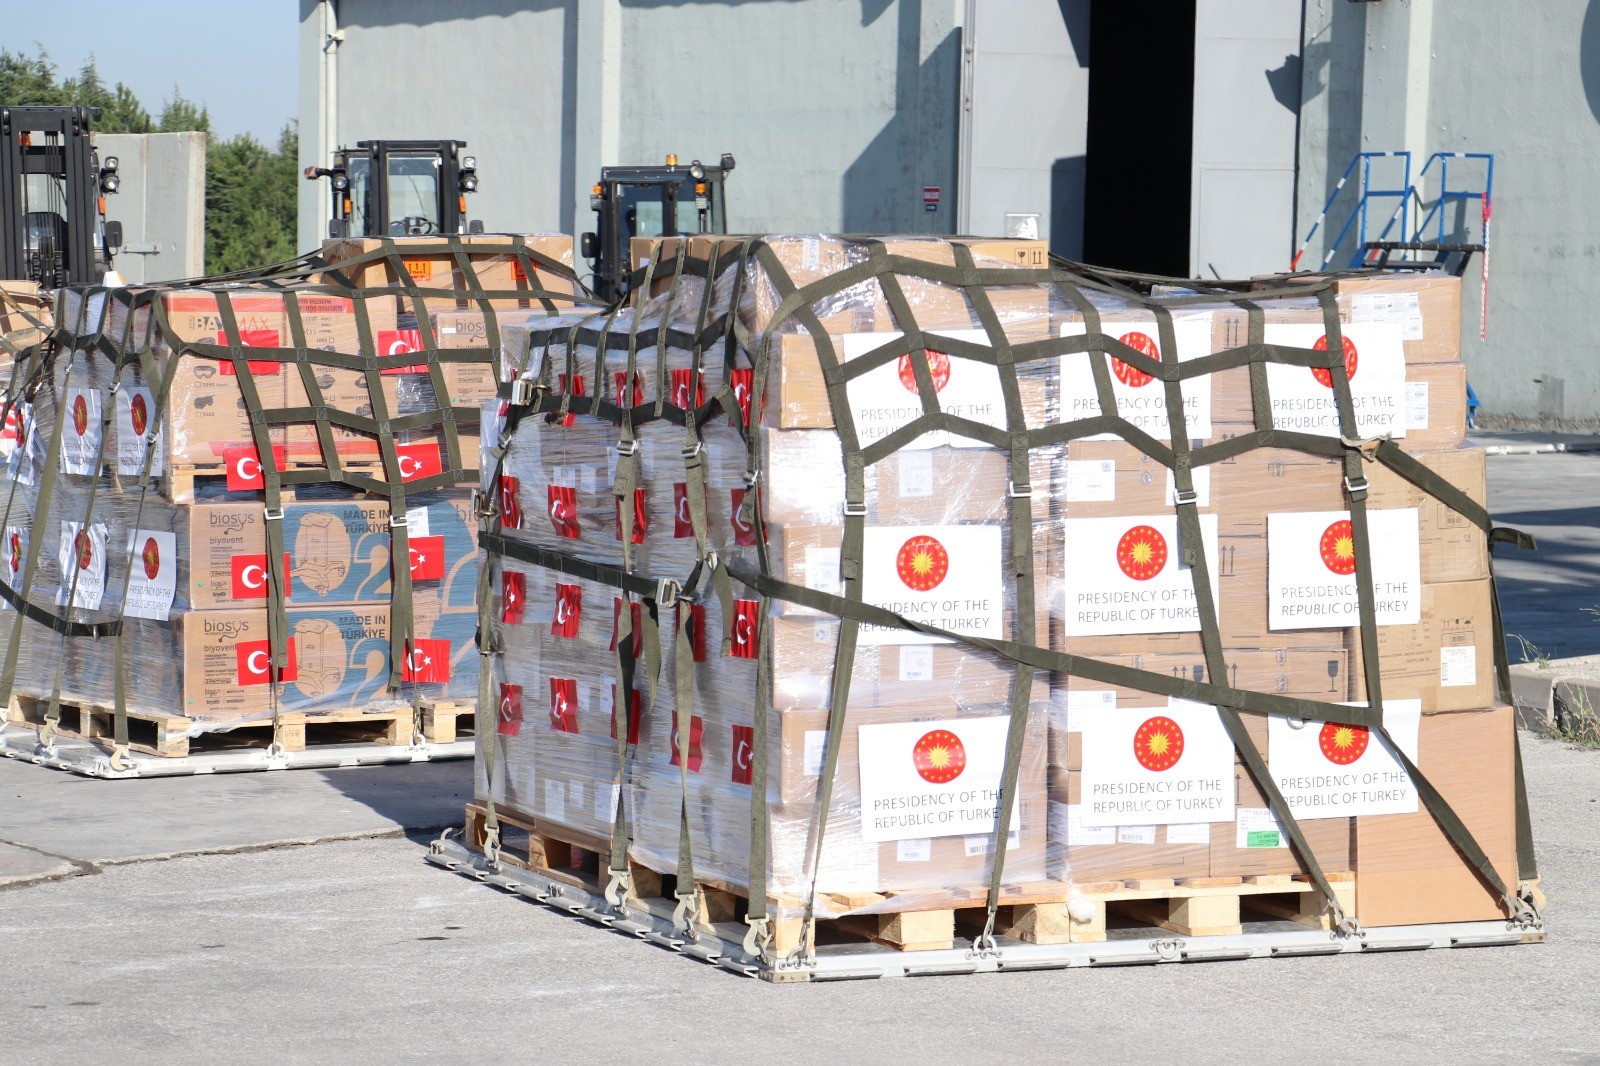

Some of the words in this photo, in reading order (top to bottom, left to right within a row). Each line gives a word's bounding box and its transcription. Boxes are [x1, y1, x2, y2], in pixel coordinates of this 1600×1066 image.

[1182, 396, 1198, 408] HE
[1352, 397, 1367, 409] OF
[1370, 396, 1394, 408] THE
[861, 406, 924, 420] PRESIDEN
[968, 404, 992, 416] THE
[1134, 416, 1149, 428] OF
[1273, 414, 1329, 429] REPUBLIC
[210, 511, 254, 528] biosys
[344, 510, 376, 520] MADE
[378, 509, 390, 519] IN
[344, 522, 390, 534] TÜRKİYE
[210, 536, 244, 545] biyovent
[1385, 582, 1408, 594] THE
[1078, 590, 1157, 604] PRESIDENCY
[1161, 590, 1178, 601] OF
[1182, 588, 1196, 599] TH
[942, 600, 960, 612] OF
[964, 600, 989, 610] THE
[1282, 602, 1340, 616] REPUBLIC
[340, 616, 371, 626] MADE
[374, 615, 386, 624] IN
[1078, 609, 1138, 622] REPUBLIC
[1140, 608, 1158, 620] OF
[1160, 607, 1199, 618] TURKE
[204, 619, 249, 636] biosys
[940, 617, 990, 630] TURKEY
[340, 628, 386, 639] TÜRKİYE
[1093, 781, 1172, 795] PRESIDENCY
[1177, 780, 1194, 792] OF
[1198, 779, 1222, 791] THE
[1281, 774, 1358, 789] PRESIDENCY
[1363, 773, 1378, 785] OF
[1382, 771, 1406, 783] THE
[874, 792, 955, 811] PRESIDENCY
[960, 791, 976, 802] OF
[1342, 792, 1359, 804] OF
[1362, 789, 1407, 802] TURKEY
[1093, 800, 1152, 813] REPUBLIC
[1156, 799, 1172, 811] OF
[1175, 797, 1223, 810] TURKEY
[875, 812, 935, 829] REPUBLIC
[938, 811, 954, 823] OF
[958, 807, 1001, 821] TURKE
